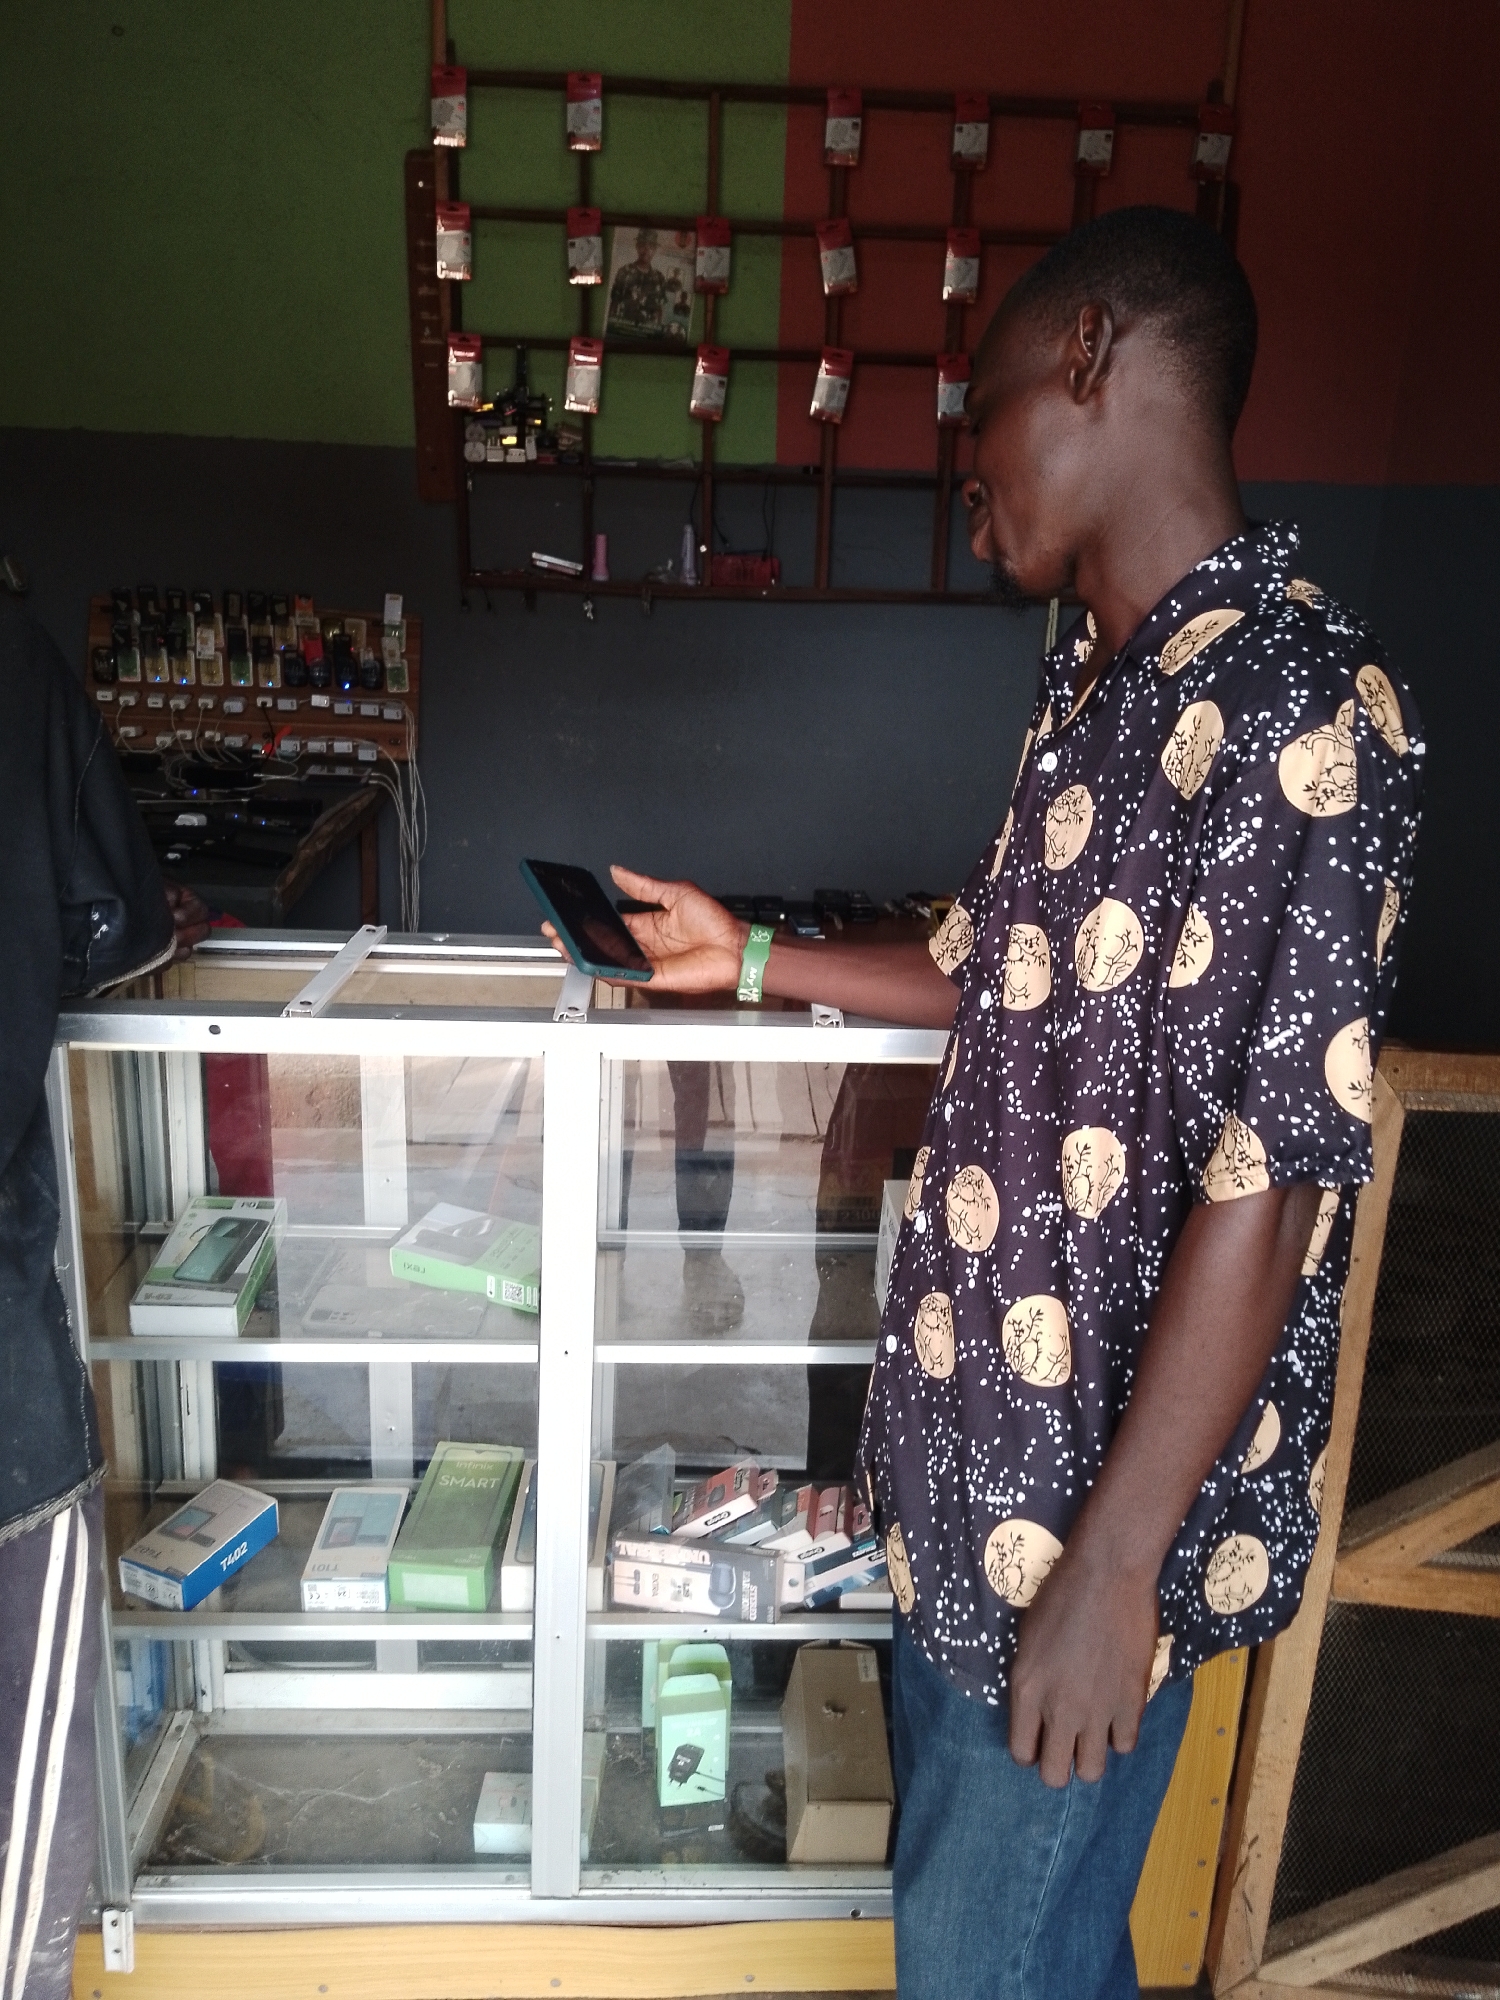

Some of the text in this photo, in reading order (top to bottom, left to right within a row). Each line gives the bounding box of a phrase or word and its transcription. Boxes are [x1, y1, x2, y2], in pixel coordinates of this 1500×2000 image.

[746, 966, 758, 987] My
[438, 1474, 501, 1489] SMART
[220, 1541, 248, 1572] T402
